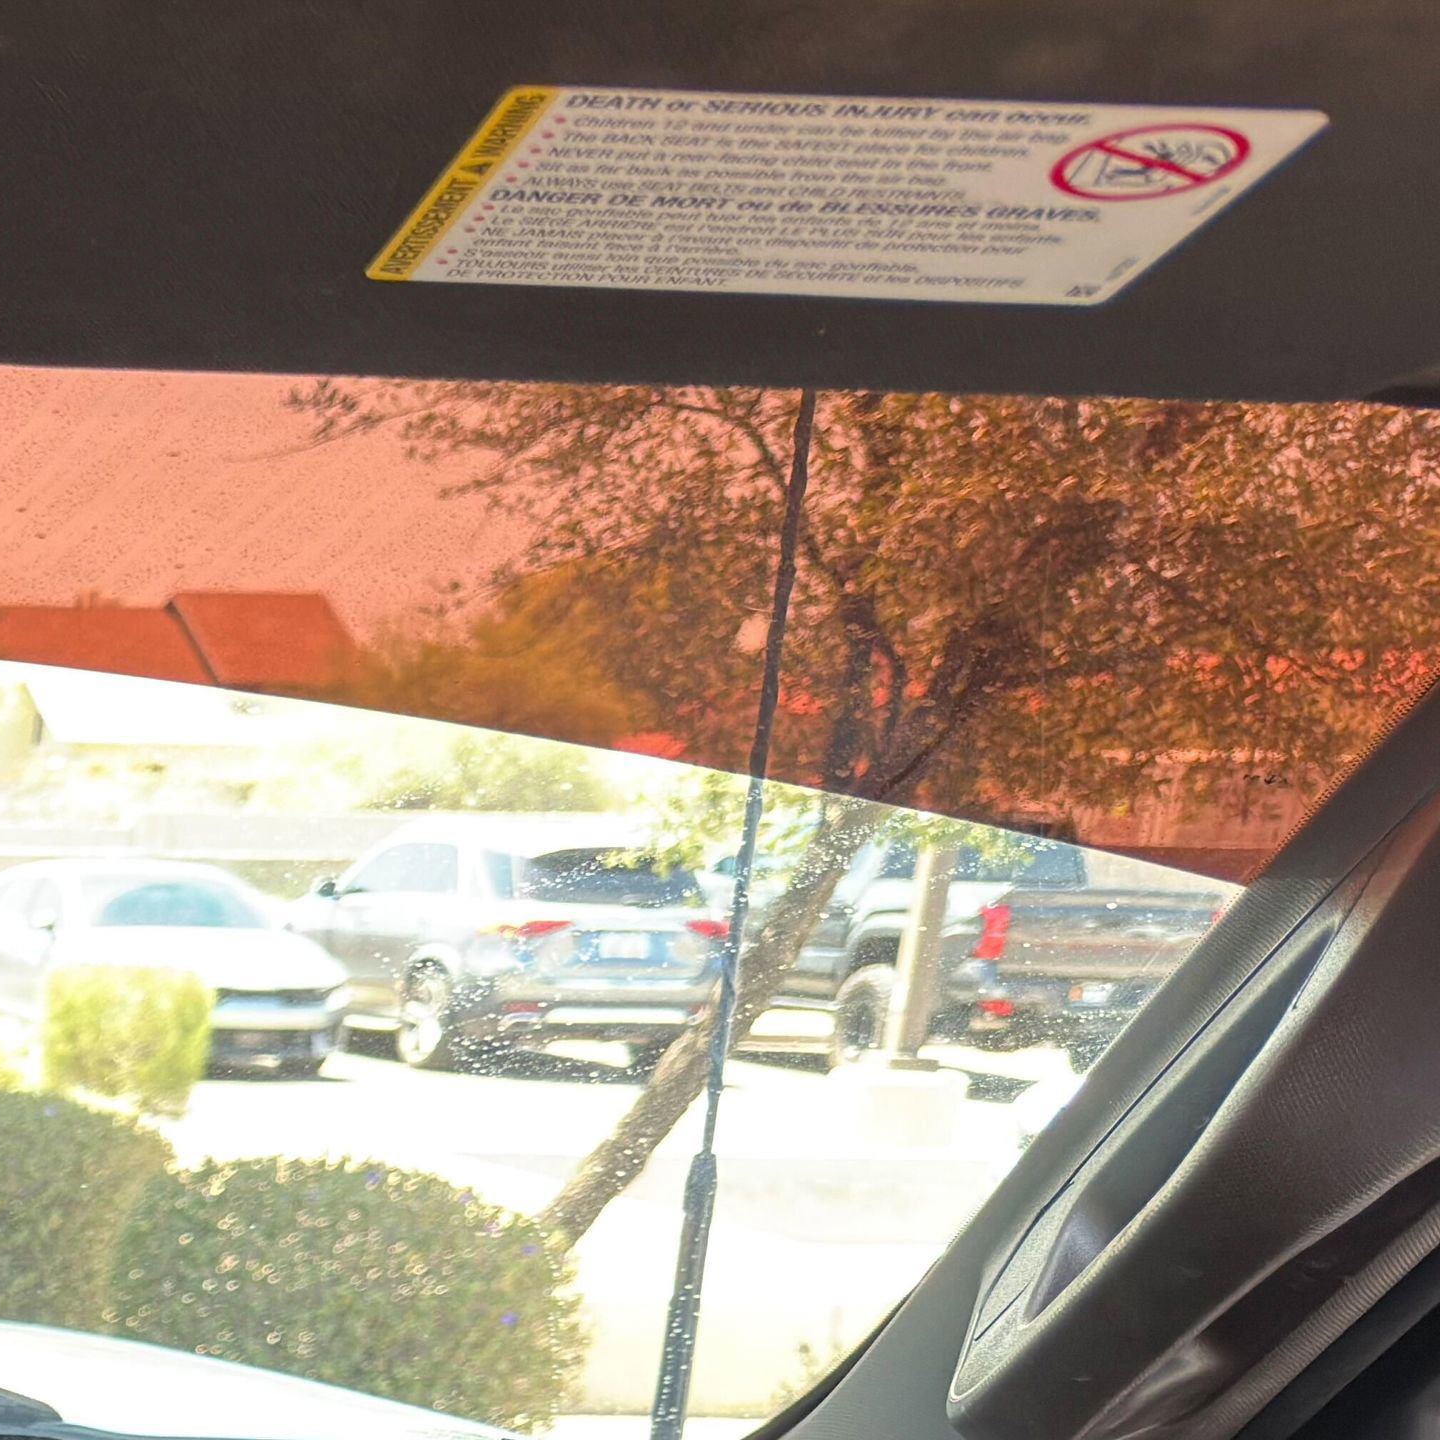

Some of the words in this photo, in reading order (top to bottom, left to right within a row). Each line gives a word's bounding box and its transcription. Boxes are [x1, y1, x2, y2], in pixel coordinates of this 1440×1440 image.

[566, 95, 662, 110] DEATH
[667, 100, 692, 112] or
[703, 99, 828, 117] SERIOUS
[832, 104, 942, 119] INJURY
[945, 109, 1000, 122] can
[1006, 110, 1090, 125] occur.
[490, 189, 601, 205] DANGER
[608, 193, 647, 207] DE
[651, 195, 734, 209] MORT
[737, 200, 772, 212] ou
[779, 201, 813, 212] de
[820, 202, 980, 218] BLESSURES
[987, 207, 1099, 222] GRAVES.
